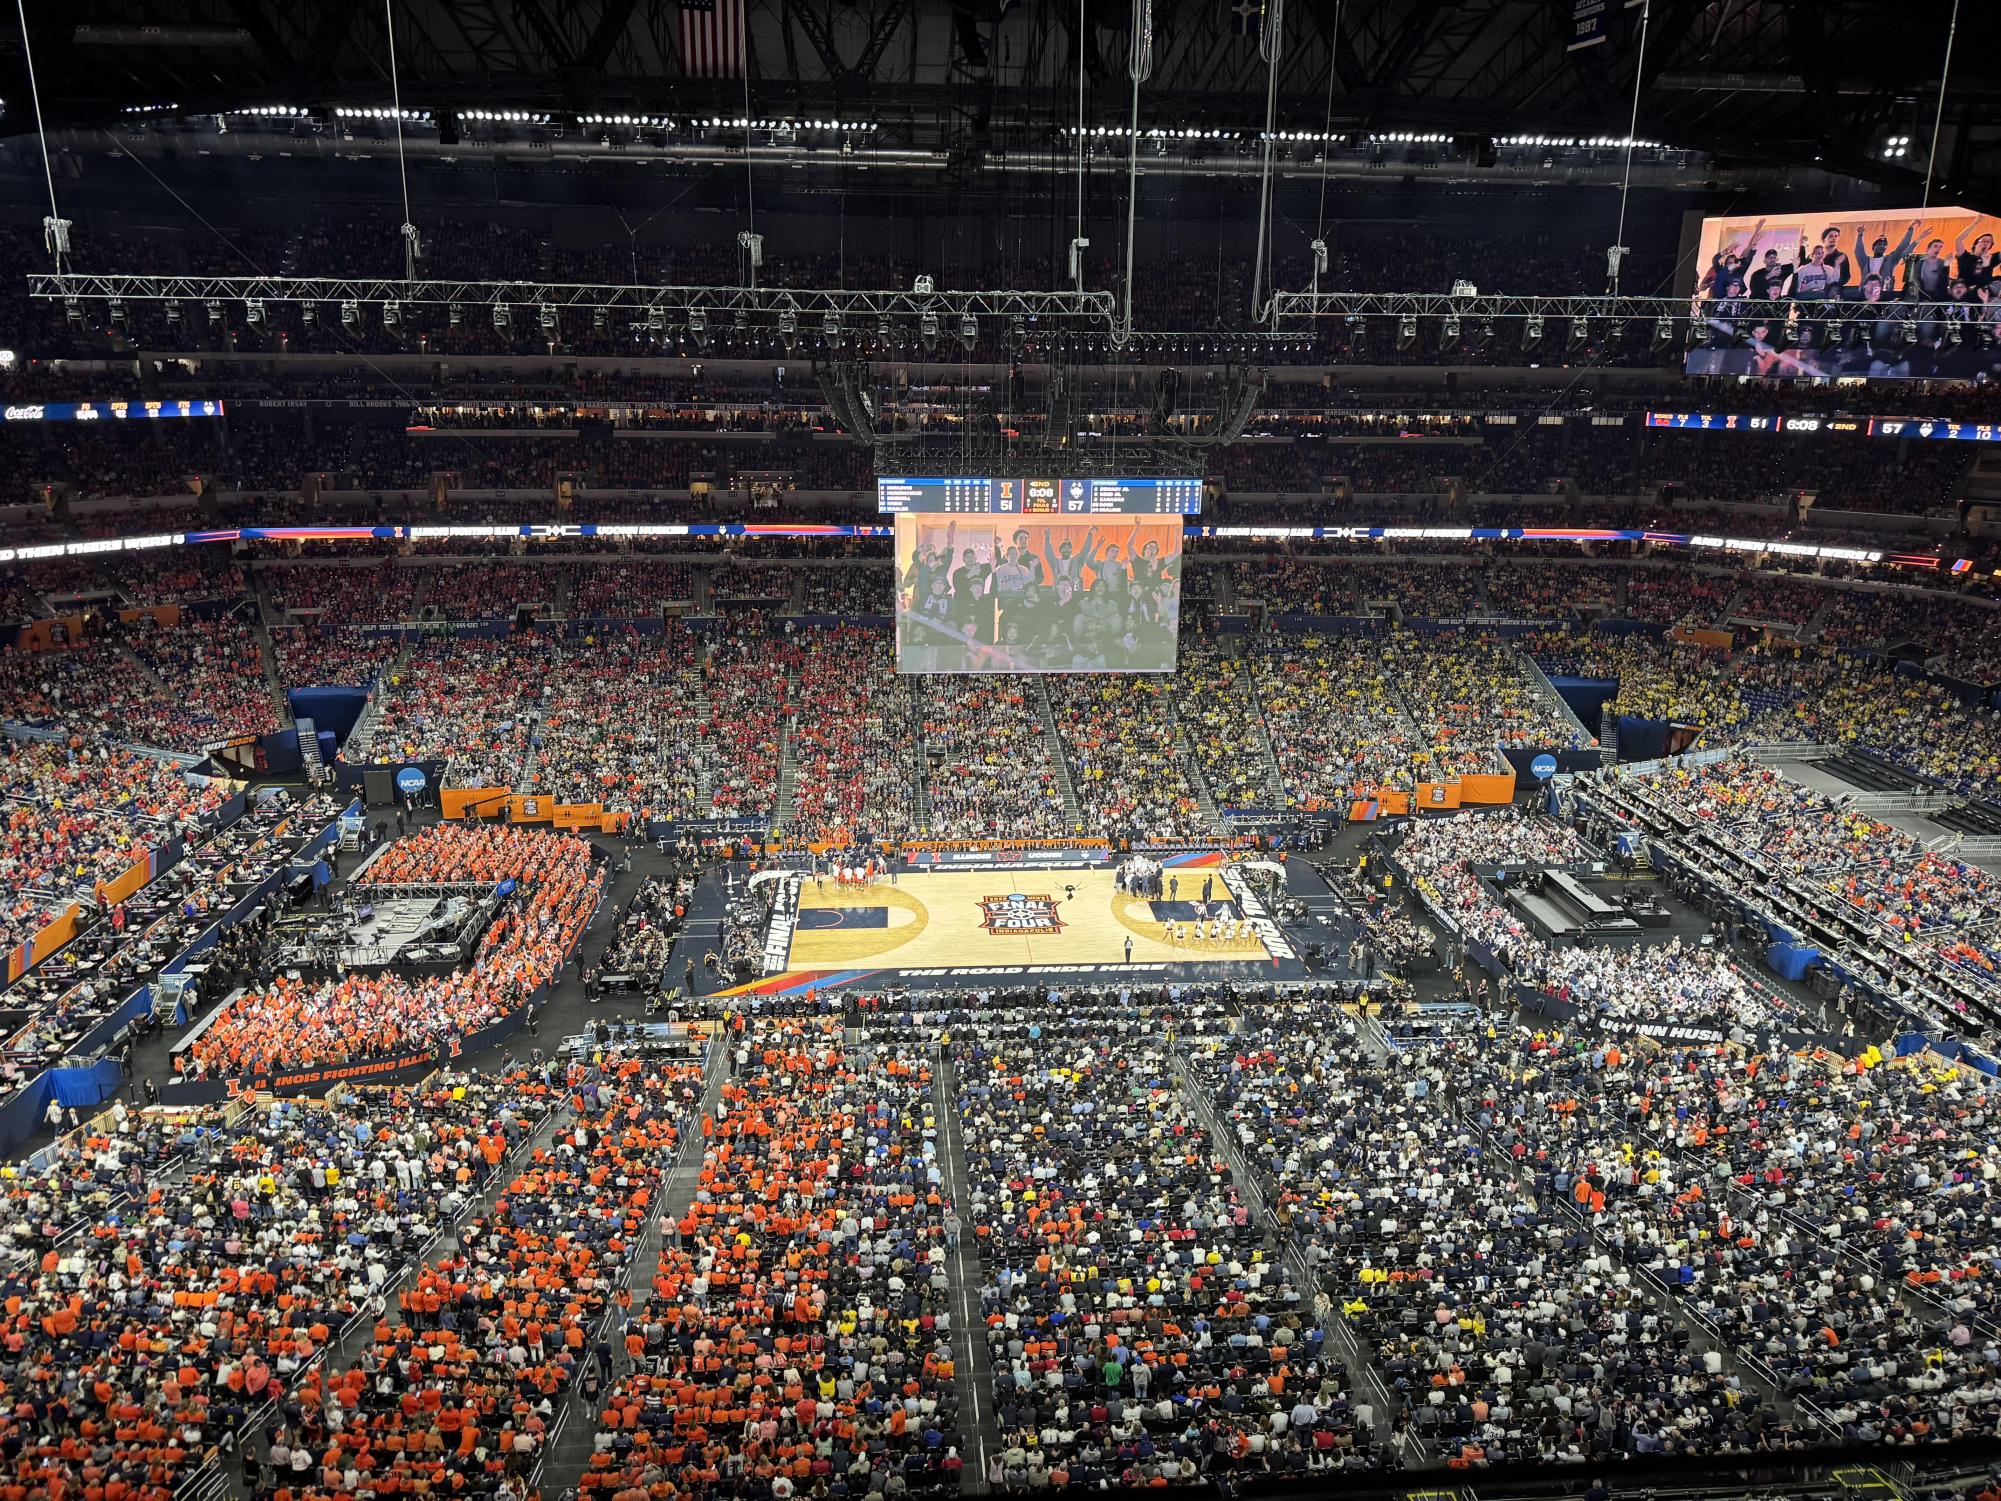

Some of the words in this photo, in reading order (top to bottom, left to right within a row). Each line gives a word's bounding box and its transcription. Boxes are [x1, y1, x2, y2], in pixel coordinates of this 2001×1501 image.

[1576, 18, 1597, 35] 1987
[1750, 418, 1767, 429] 51
[1786, 419, 1819, 431] 6:08
[1834, 423, 1857, 431] 2ND
[1882, 423, 1903, 434] 57
[1948, 430, 1958, 438] 2
[1975, 431, 1991, 440] 10
[1029, 488, 1054, 498] 6:08
[1000, 500, 1013, 511] 51
[1068, 500, 1084, 511] 57
[17, 544, 65, 559] THEN
[67, 539, 123, 554] THERE
[124, 534, 172, 549] WERE
[1689, 536, 1724, 547] AND
[1725, 539, 1766, 551] THEN
[1766, 543, 1819, 556] THERE
[1818, 548, 1868, 560] WERE
[1533, 764, 1556, 773] NCAA
[400, 777, 426, 787] NCAA
[1028, 851, 1063, 859] UCONN
[934, 861, 1085, 870] INDIANAPOLIS
[988, 901, 1048, 911] FINAL
[994, 918, 1053, 928] FOUR
[765, 914, 795, 955] FINAL
[898, 969, 948, 977] THE
[950, 967, 1023, 975] ROAD
[1027, 965, 1095, 974] ENDS
[1099, 964, 1167, 972] HERE
[322, 1060, 396, 1080] FIGHTING
